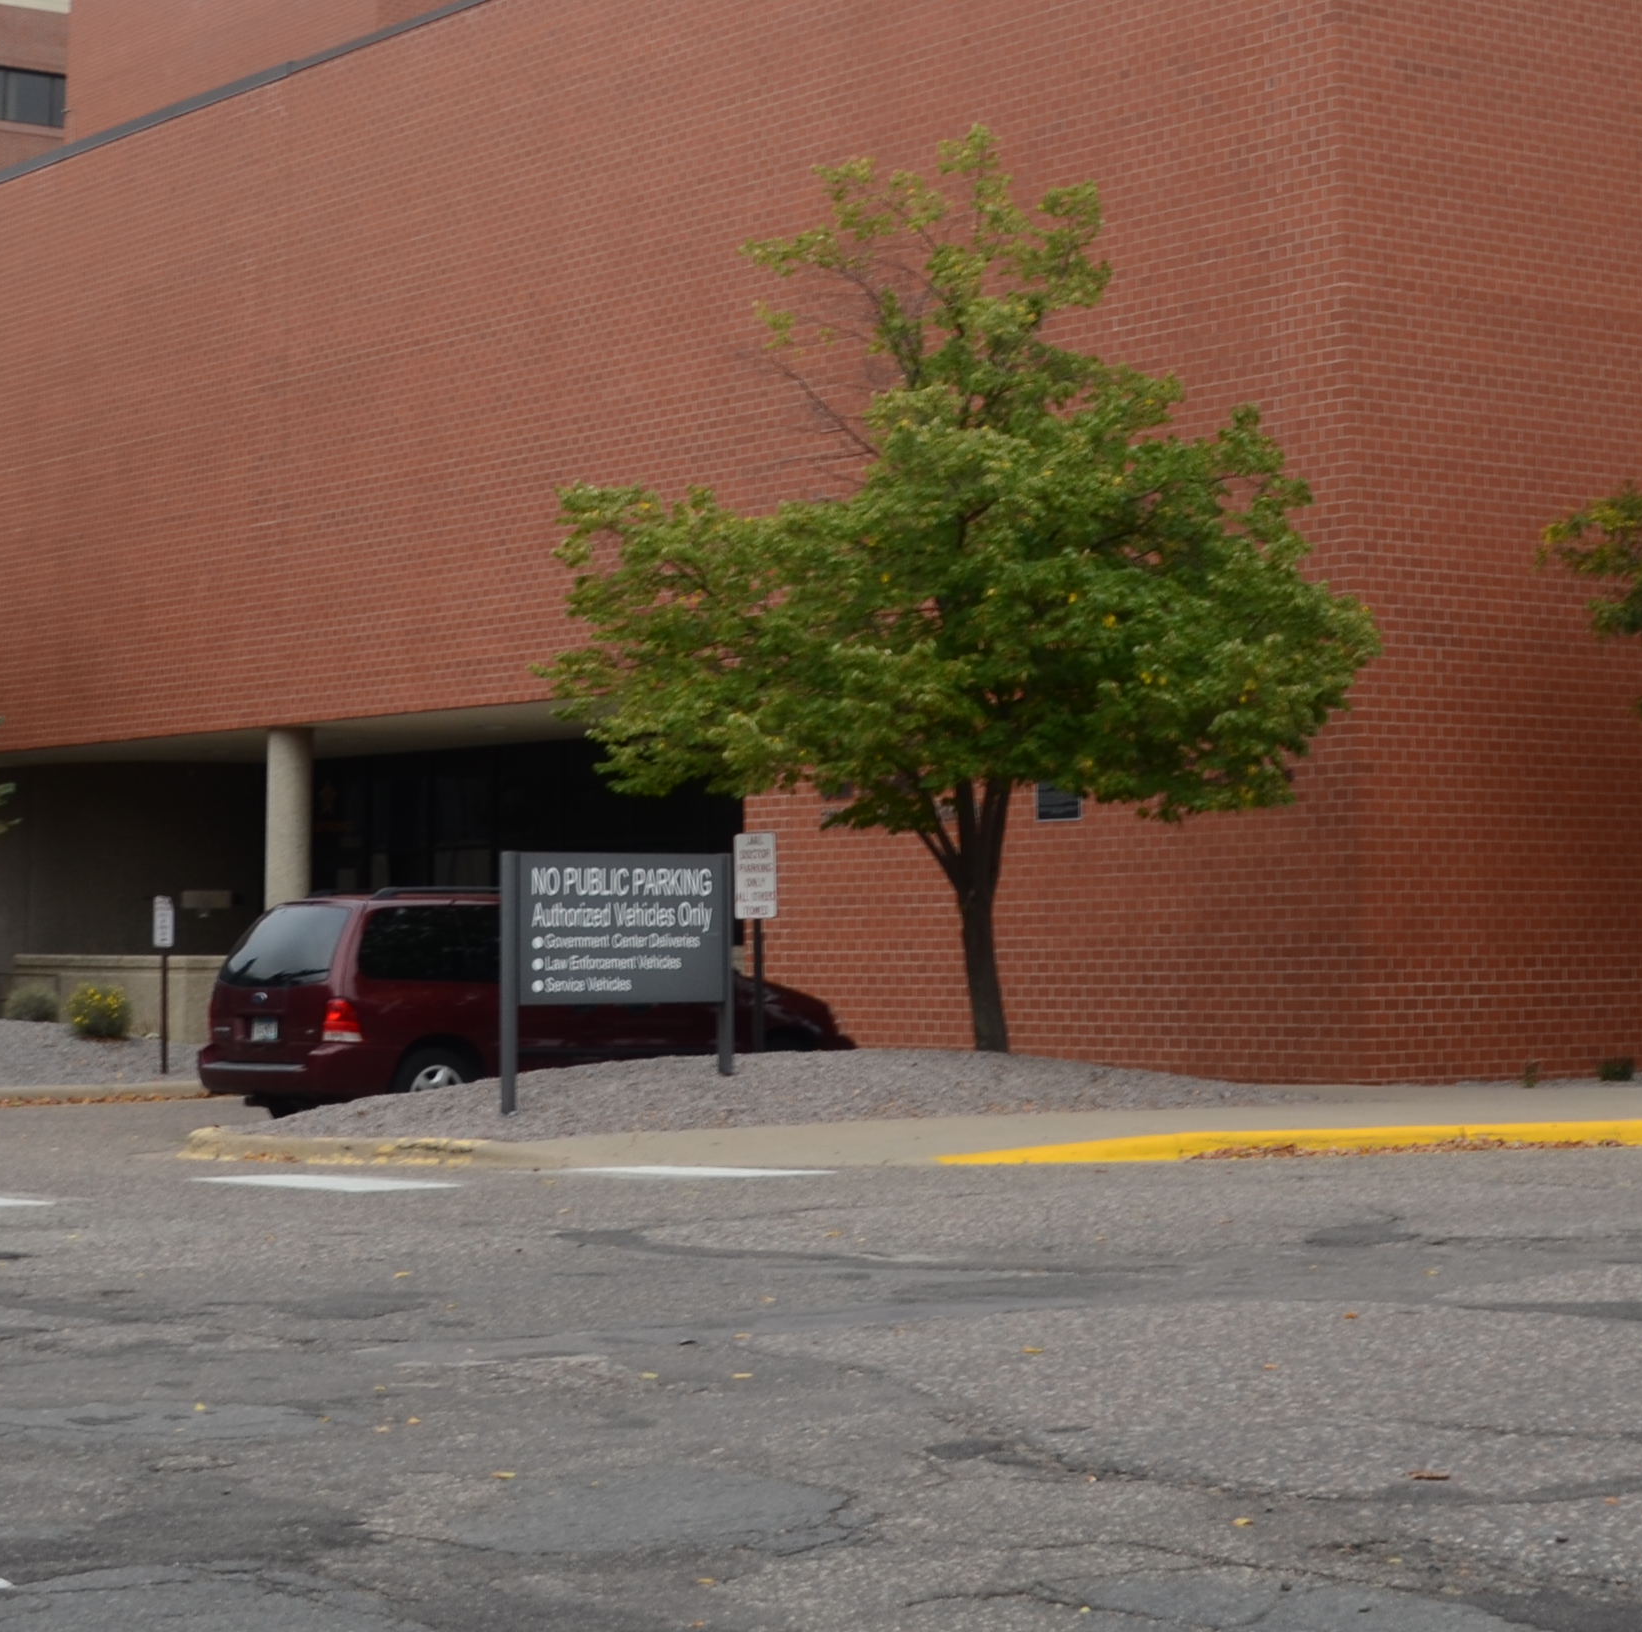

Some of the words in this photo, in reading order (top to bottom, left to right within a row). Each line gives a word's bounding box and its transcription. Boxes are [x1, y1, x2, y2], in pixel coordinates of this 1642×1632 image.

[739, 849, 771, 860] DOCTOR
[738, 863, 773, 874] PARKING
[531, 867, 560, 896] NO
[563, 867, 630, 896] PUBLIC
[632, 868, 713, 896] PARKING
[531, 901, 611, 928] Authorized
[613, 901, 676, 928] Vehicles
[677, 901, 713, 933] Only
[544, 933, 611, 949] Government
[611, 933, 648, 949] Center
[648, 933, 701, 949] Deliveries
[544, 956, 569, 972] Law
[569, 955, 637, 971] Enforcement
[637, 955, 682, 970] Vehicles
[544, 976, 586, 993] Service
[586, 976, 632, 992] Vehicles
